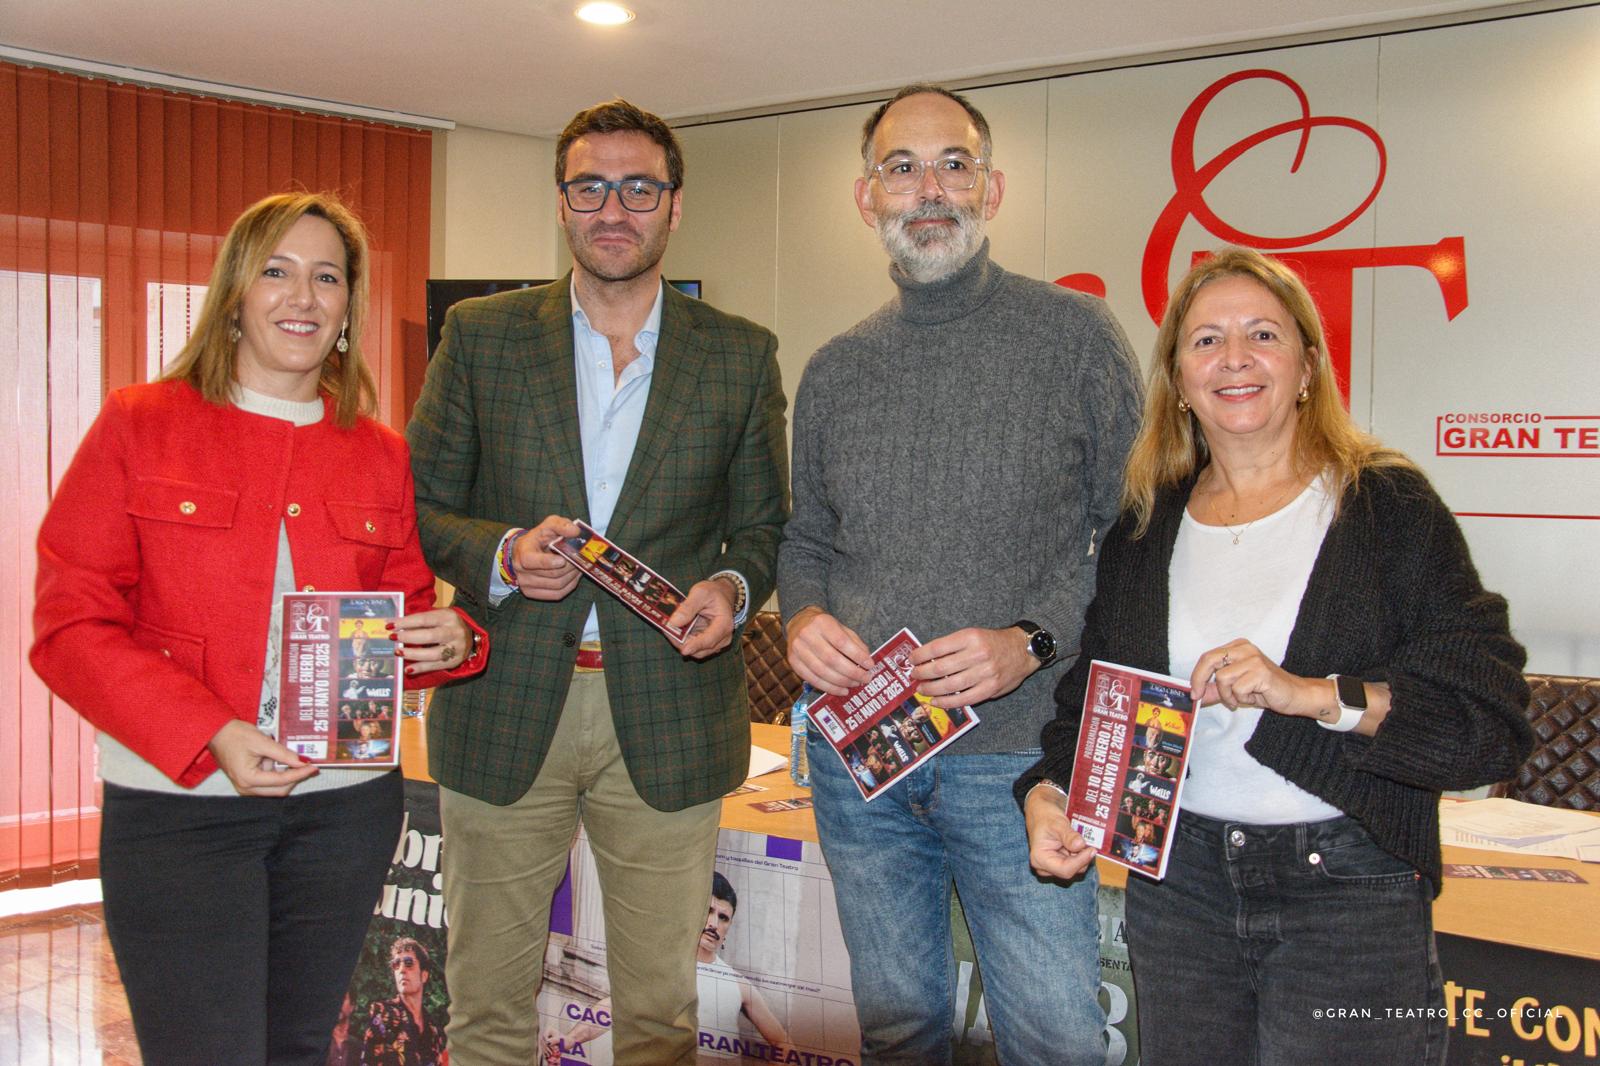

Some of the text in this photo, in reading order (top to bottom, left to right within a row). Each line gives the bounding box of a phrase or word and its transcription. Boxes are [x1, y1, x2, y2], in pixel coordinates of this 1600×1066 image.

[1443, 428, 1541, 449] GRAN
[1444, 413, 1542, 424] CONSORCIO
[298, 644, 314, 720] DEL 10 DE ENERO AL
[314, 643, 330, 732] 25 DE MAYO DE 2025
[845, 716, 859, 731] 25
[854, 712, 866, 724] DE
[860, 698, 882, 720] MAYO
[877, 694, 888, 706] DE
[883, 680, 904, 700] 2025
[850, 694, 864, 708] 10
[858, 690, 870, 702] DE
[864, 674, 888, 698] ENERO
[884, 670, 895, 682] AL
[1086, 720, 1113, 802] DEL 10 DE ENERO AL
[1096, 723, 1127, 820] 25 DE MAYO DE 2025
[559, 1038, 586, 1058] LA
